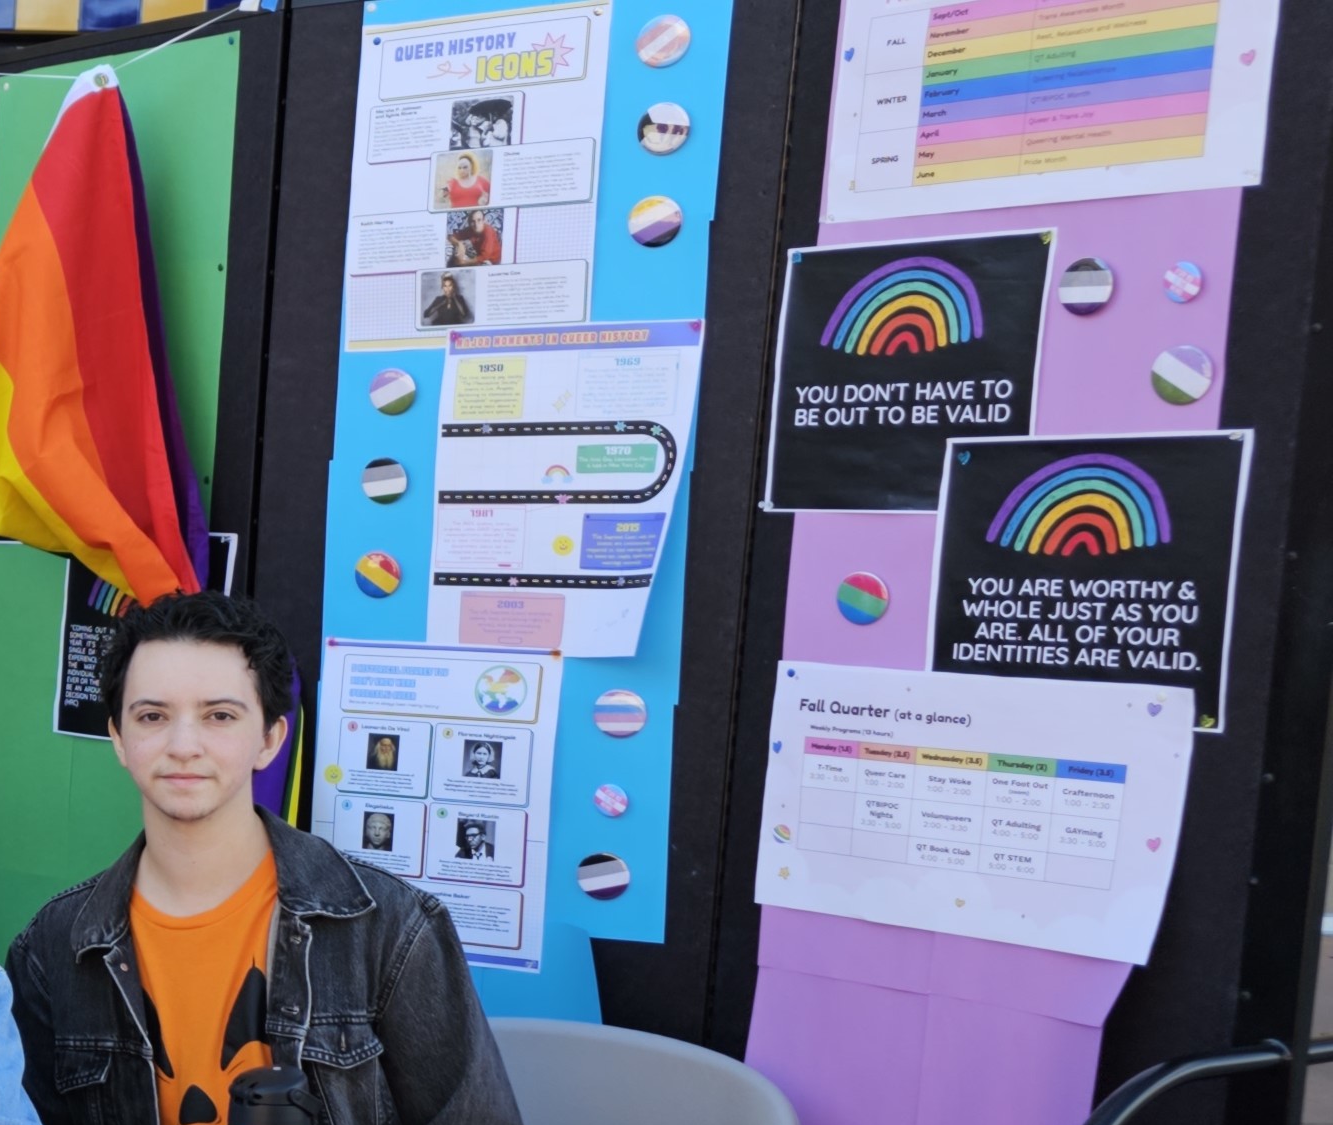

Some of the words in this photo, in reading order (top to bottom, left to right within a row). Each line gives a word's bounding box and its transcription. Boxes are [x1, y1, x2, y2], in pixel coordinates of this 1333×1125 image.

[395, 41, 444, 62] QUEER
[448, 32, 516, 55] HISTORY
[887, 38, 906, 46] FALL
[927, 46, 966, 58] December
[475, 48, 554, 83] ICONS
[926, 68, 957, 79] January
[877, 96, 907, 105] WINTER
[872, 156, 898, 164] SPRING
[917, 170, 935, 178] June
[456, 336, 491, 348] MAJOR
[493, 334, 543, 347] MOMENTS
[545, 333, 558, 345] IN
[561, 331, 597, 344] QUEER
[599, 329, 649, 343] HISTORY
[796, 385, 837, 403] YOU
[844, 383, 909, 402] DON'T
[916, 381, 974, 400] HAVE
[981, 380, 1013, 398] TO
[794, 408, 820, 426] BE
[825, 407, 868, 426] OUT
[875, 407, 904, 425] TO
[912, 406, 939, 424] BE
[946, 404, 1011, 423] VALID
[968, 578, 1013, 596] YOU
[1019, 579, 1063, 597] ARE
[1070, 580, 1173, 599] WORTHY
[1178, 582, 1196, 600] &
[963, 600, 1042, 618] WHOLE
[1048, 602, 1106, 620] JUST
[1111, 603, 1142, 621] AS
[1148, 604, 1198, 623] YOU
[975, 622, 1021, 640] ARE.
[1028, 624, 1068, 642] ALL
[1075, 625, 1107, 643] OF
[1113, 627, 1179, 646] YOUR
[952, 643, 1069, 664] IDENTITIES
[1074, 648, 1120, 667] ARE
[1127, 650, 1201, 671] VALID.
[799, 699, 824, 713] Fall
[830, 701, 890, 718] Quarter
[895, 709, 911, 721] (at
[926, 712, 971, 727] glance)
[1063, 789, 1115, 799] Crafternoon
[1065, 827, 1102, 838] GAYming
